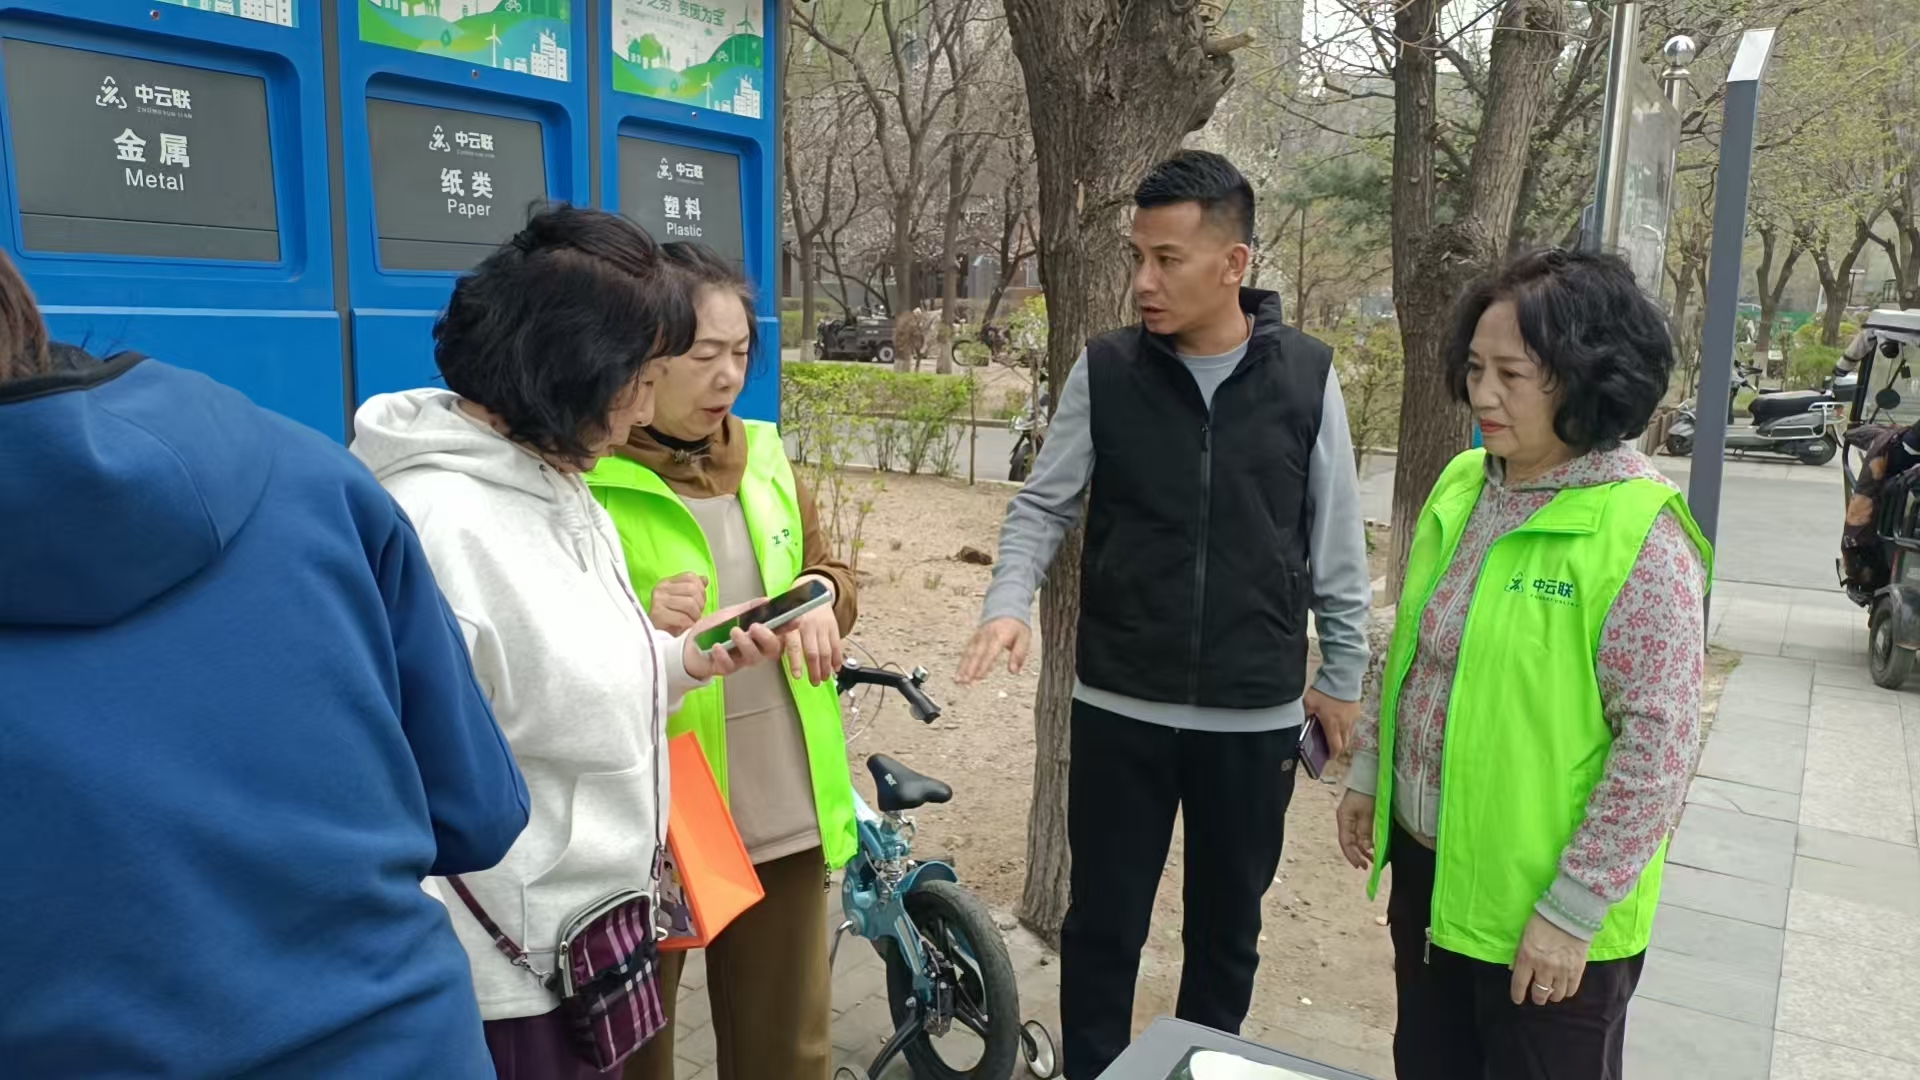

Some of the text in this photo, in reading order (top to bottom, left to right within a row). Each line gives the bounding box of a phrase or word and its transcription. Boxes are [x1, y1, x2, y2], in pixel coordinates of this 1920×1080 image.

[134, 83, 192, 110] 中云联
[113, 127, 190, 168] 金属
[455, 130, 494, 151] 中云联
[125, 167, 184, 191] Metal
[440, 167, 493, 199] 纸类
[447, 198, 491, 219] Paper
[663, 194, 702, 221] 塑料
[666, 221, 703, 237] Plastic
[1532, 578, 1574, 598] 中云联
